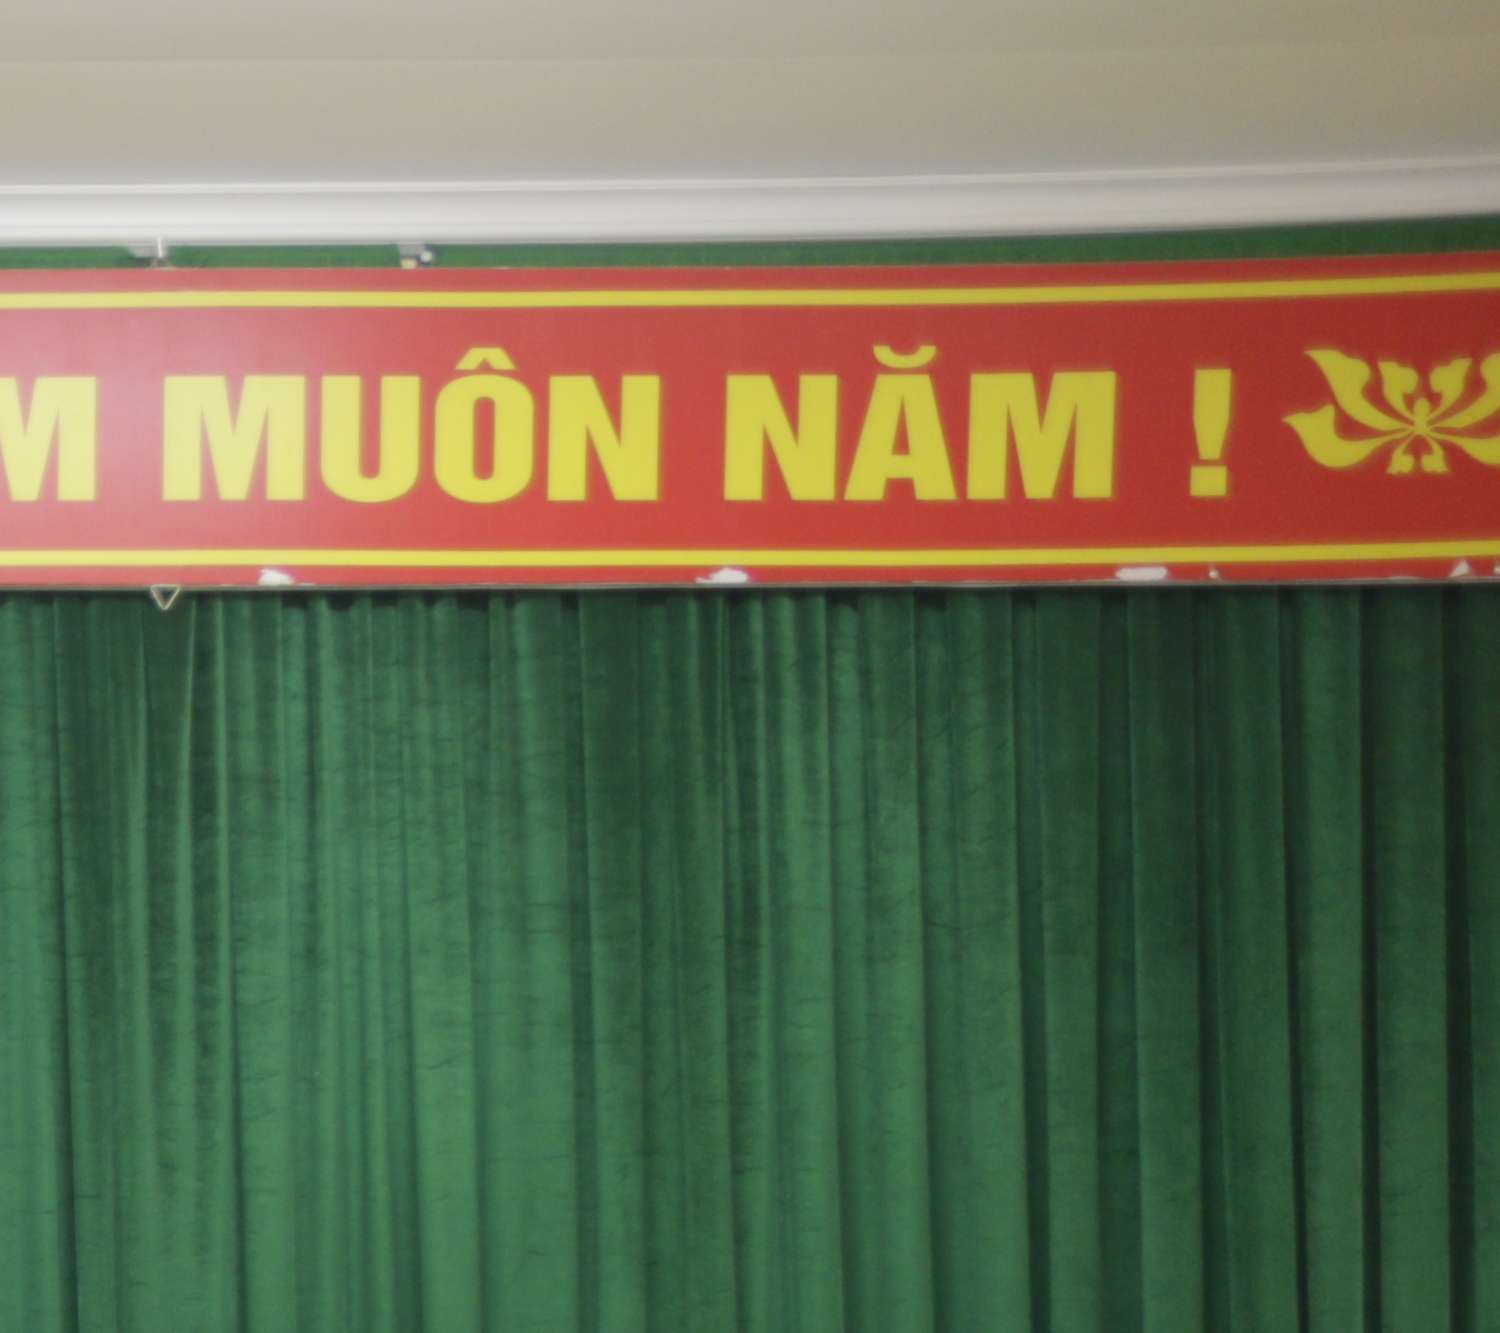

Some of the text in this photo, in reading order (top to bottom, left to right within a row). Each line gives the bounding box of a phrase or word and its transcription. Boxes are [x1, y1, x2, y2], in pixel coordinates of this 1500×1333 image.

[162, 347, 663, 504] MUÔN
[724, 344, 1118, 501] NĂM
[1190, 368, 1232, 496] !
